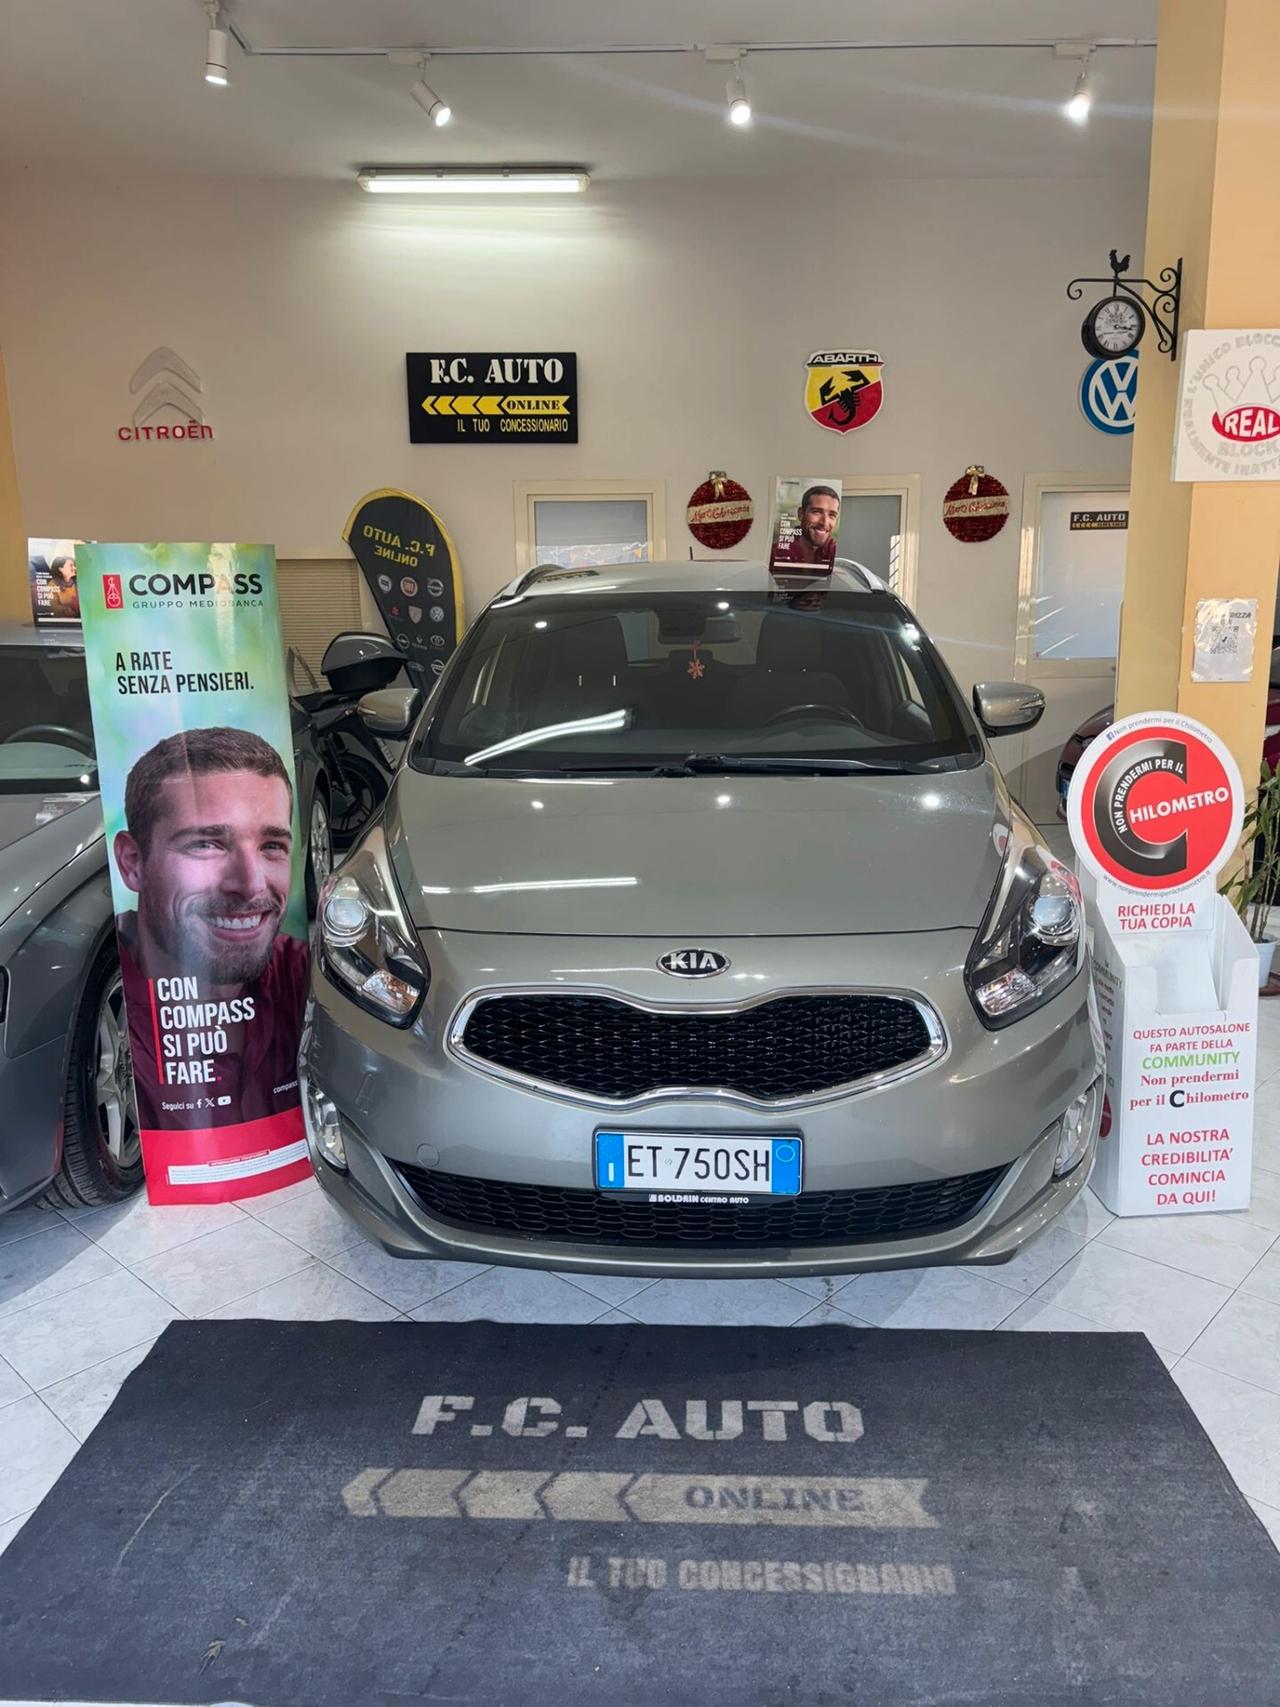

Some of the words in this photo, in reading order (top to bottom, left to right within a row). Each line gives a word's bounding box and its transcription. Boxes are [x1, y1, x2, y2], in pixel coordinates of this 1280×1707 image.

[813, 354, 877, 364] ABARTH
[430, 358, 475, 384] F.C.
[485, 358, 564, 384] AUTO
[506, 399, 560, 411] ONLINE
[457, 418, 466, 432] IL
[472, 418, 491, 432] TUO
[500, 418, 569, 432] CONCESSIONARIO
[1224, 408, 1280, 438] REAL
[1073, 513, 1093, 522] F.C.
[1096, 513, 1126, 521] AUTO
[129, 573, 263, 596] COMPASS
[132, 600, 184, 609] GRUPPO
[116, 652, 126, 671] A
[130, 651, 173, 671] RATE
[117, 675, 171, 695] SENZA
[176, 671, 254, 693] PENSIERI.
[1113, 725, 1127, 737] Non
[1127, 717, 1162, 730] prendermi
[1155, 759, 1174, 770] PER
[1175, 761, 1184, 774] IL
[1114, 761, 1153, 808] PRENDERMI
[1114, 811, 1128, 833] NON
[1118, 903, 1175, 918] RICHIEDI
[1180, 902, 1196, 915] LA
[1120, 918, 1147, 930] TUA
[1151, 916, 1193, 929] COPIA
[670, 952, 718, 969] KIA
[157, 976, 198, 1001] CON
[159, 996, 256, 1030] COMPASS
[163, 1034, 182, 1057] SI
[188, 1024, 228, 1056] PUÒ
[1133, 1026, 1177, 1041] QUESTO
[1179, 1022, 1250, 1037] AUTOSALONE
[1150, 1043, 1162, 1053] FA
[1166, 1041, 1199, 1052] PARTE
[1201, 1039, 1233, 1050] DELLA
[1142, 1051, 1241, 1070] COMMUNITY
[1140, 1074, 1167, 1087] Non
[1171, 1069, 1240, 1088] prendermi
[161, 1101, 185, 1112] Seguici
[186, 1102, 194, 1110] su
[1129, 1098, 1152, 1111] per
[1156, 1095, 1166, 1106] il
[1147, 1133, 1165, 1146] LA
[1169, 1128, 1230, 1145] NOSTRA
[628, 1145, 662, 1178] ET
[674, 1147, 770, 1182] 750SH
[1141, 1147, 1234, 1167] CREDIBILITA'
[1148, 1169, 1226, 1186] COMINCIA
[1157, 1192, 1178, 1206] DA
[1183, 1189, 1216, 1206] QUI!
[411, 1395, 588, 1437] F.C.
[614, 1399, 865, 1442] AUTO
[685, 1485, 865, 1511] ONLINE
[567, 1556, 595, 1588] IL
[607, 1557, 667, 1590] TUO
